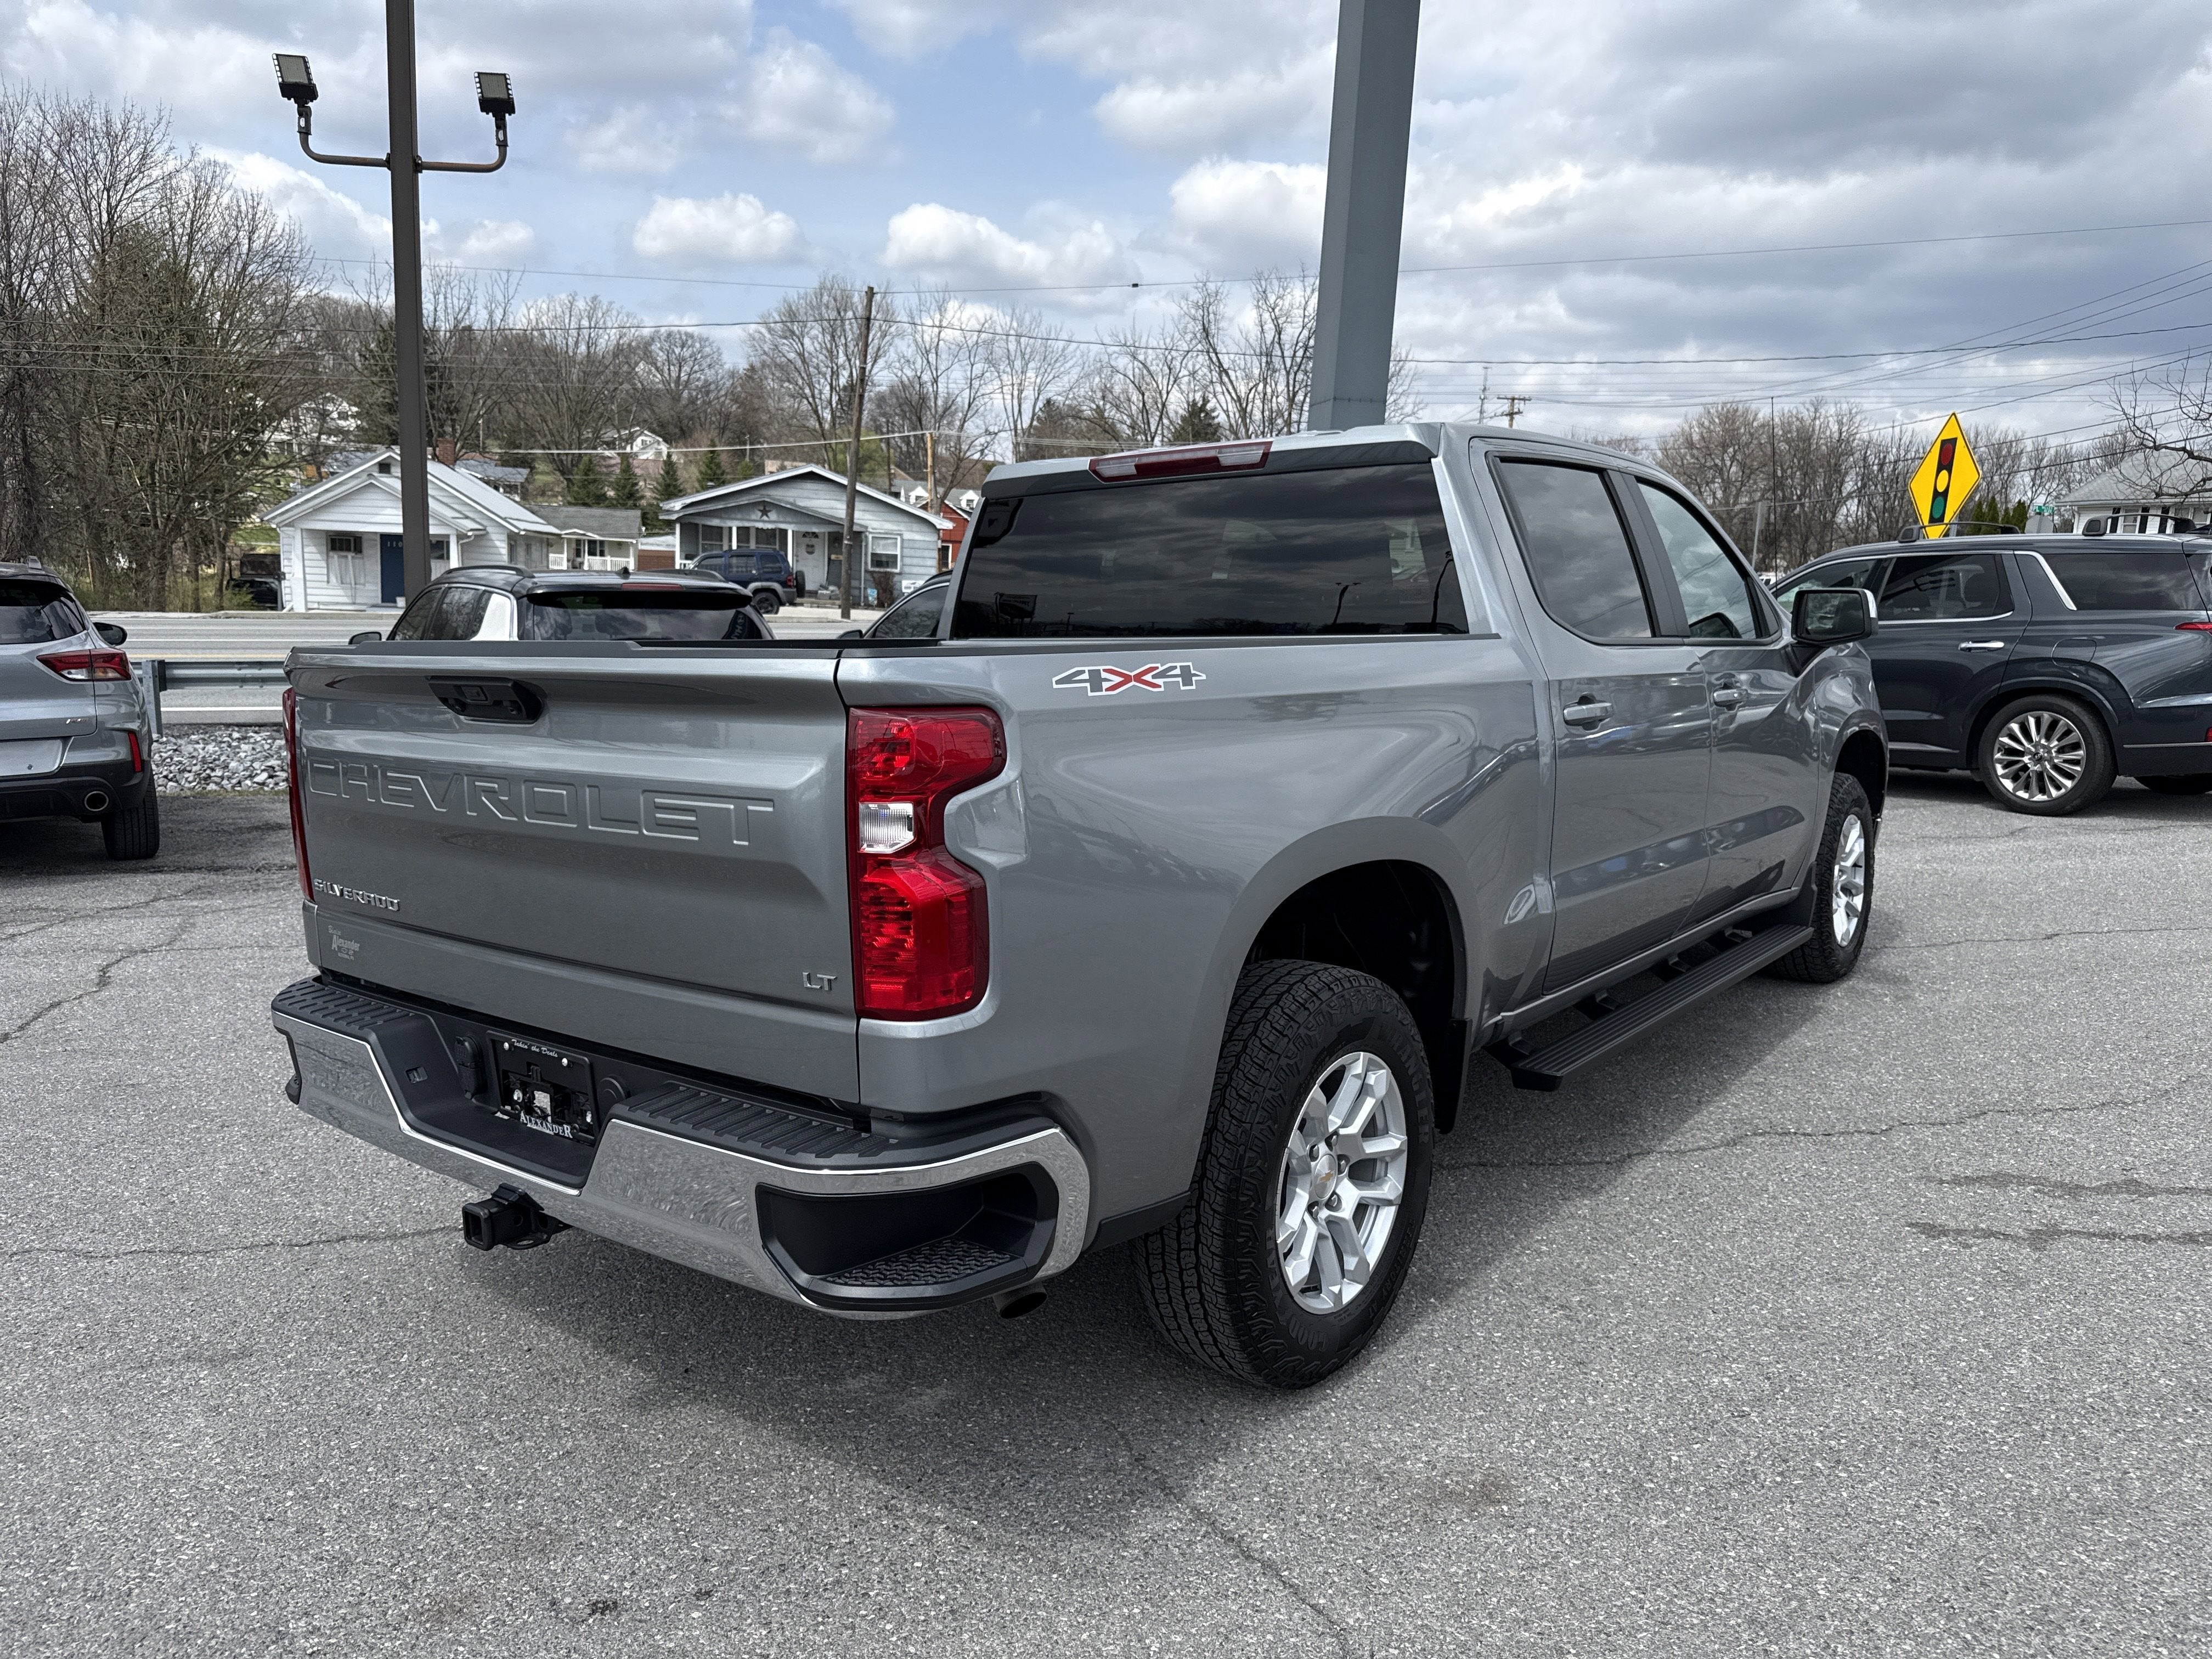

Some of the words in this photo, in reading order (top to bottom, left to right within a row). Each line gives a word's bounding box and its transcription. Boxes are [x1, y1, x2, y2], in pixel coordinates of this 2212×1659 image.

[307, 758, 775, 847] CHEVROLET
[313, 878, 400, 912] SILVERADO
[331, 934, 360, 952] Alexander
[802, 971, 838, 992] LT
[541, 1047, 558, 1058] Deals
[519, 1110, 573, 1138] ALEXANDER
